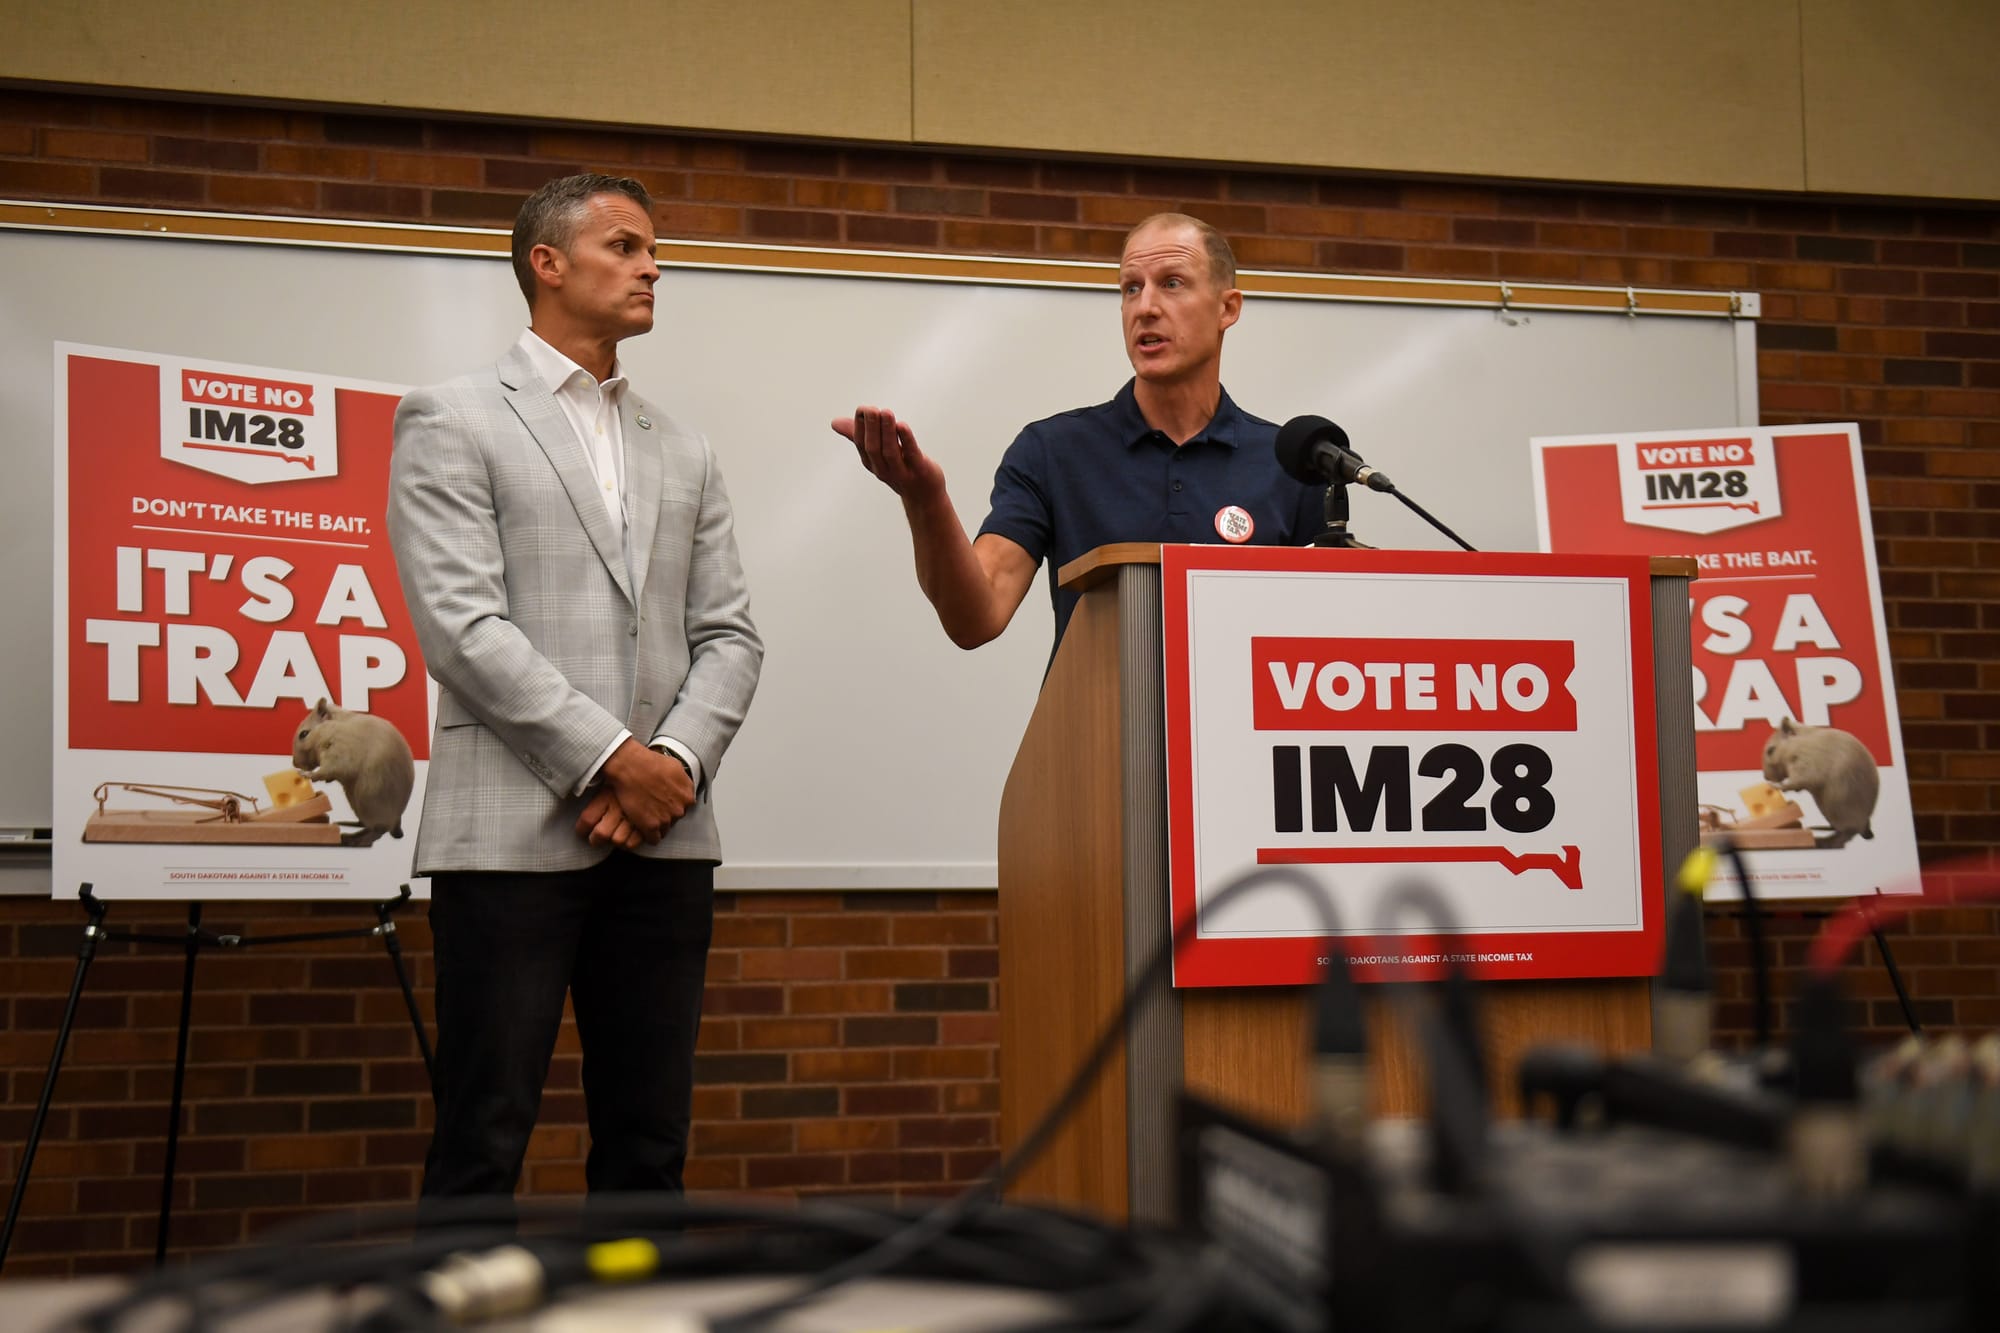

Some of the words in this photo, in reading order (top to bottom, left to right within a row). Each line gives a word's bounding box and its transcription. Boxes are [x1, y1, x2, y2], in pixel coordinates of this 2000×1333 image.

[188, 378, 257, 404] VOTE
[264, 388, 304, 409] NO
[189, 407, 305, 449] IM28
[1641, 447, 1704, 465] VOTE
[1707, 444, 1744, 462] NO
[1645, 470, 1748, 500] IM28
[132, 497, 206, 520] DON’T
[210, 504, 267, 525] TAKE
[272, 510, 313, 529] THE
[319, 514, 371, 535] BAIT.
[1723, 552, 1763, 568] THE
[1767, 550, 1817, 566] BAIT.
[117, 546, 295, 623] IT’S
[315, 563, 388, 629] A
[1772, 593, 1842, 651] A
[86, 618, 406, 712] TRAP
[1268, 661, 1438, 712] VOTE
[1456, 662, 1549, 712] NO
[1272, 743, 1556, 833] IM28
[1350, 955, 1400, 965] DAKOTANS
[1401, 954, 1440, 964] AGAINST
[1442, 954, 1449, 962] A
[1450, 954, 1476, 962] STATE
[1478, 953, 1514, 962] INCOME
[1516, 952, 1533, 961] TAX
